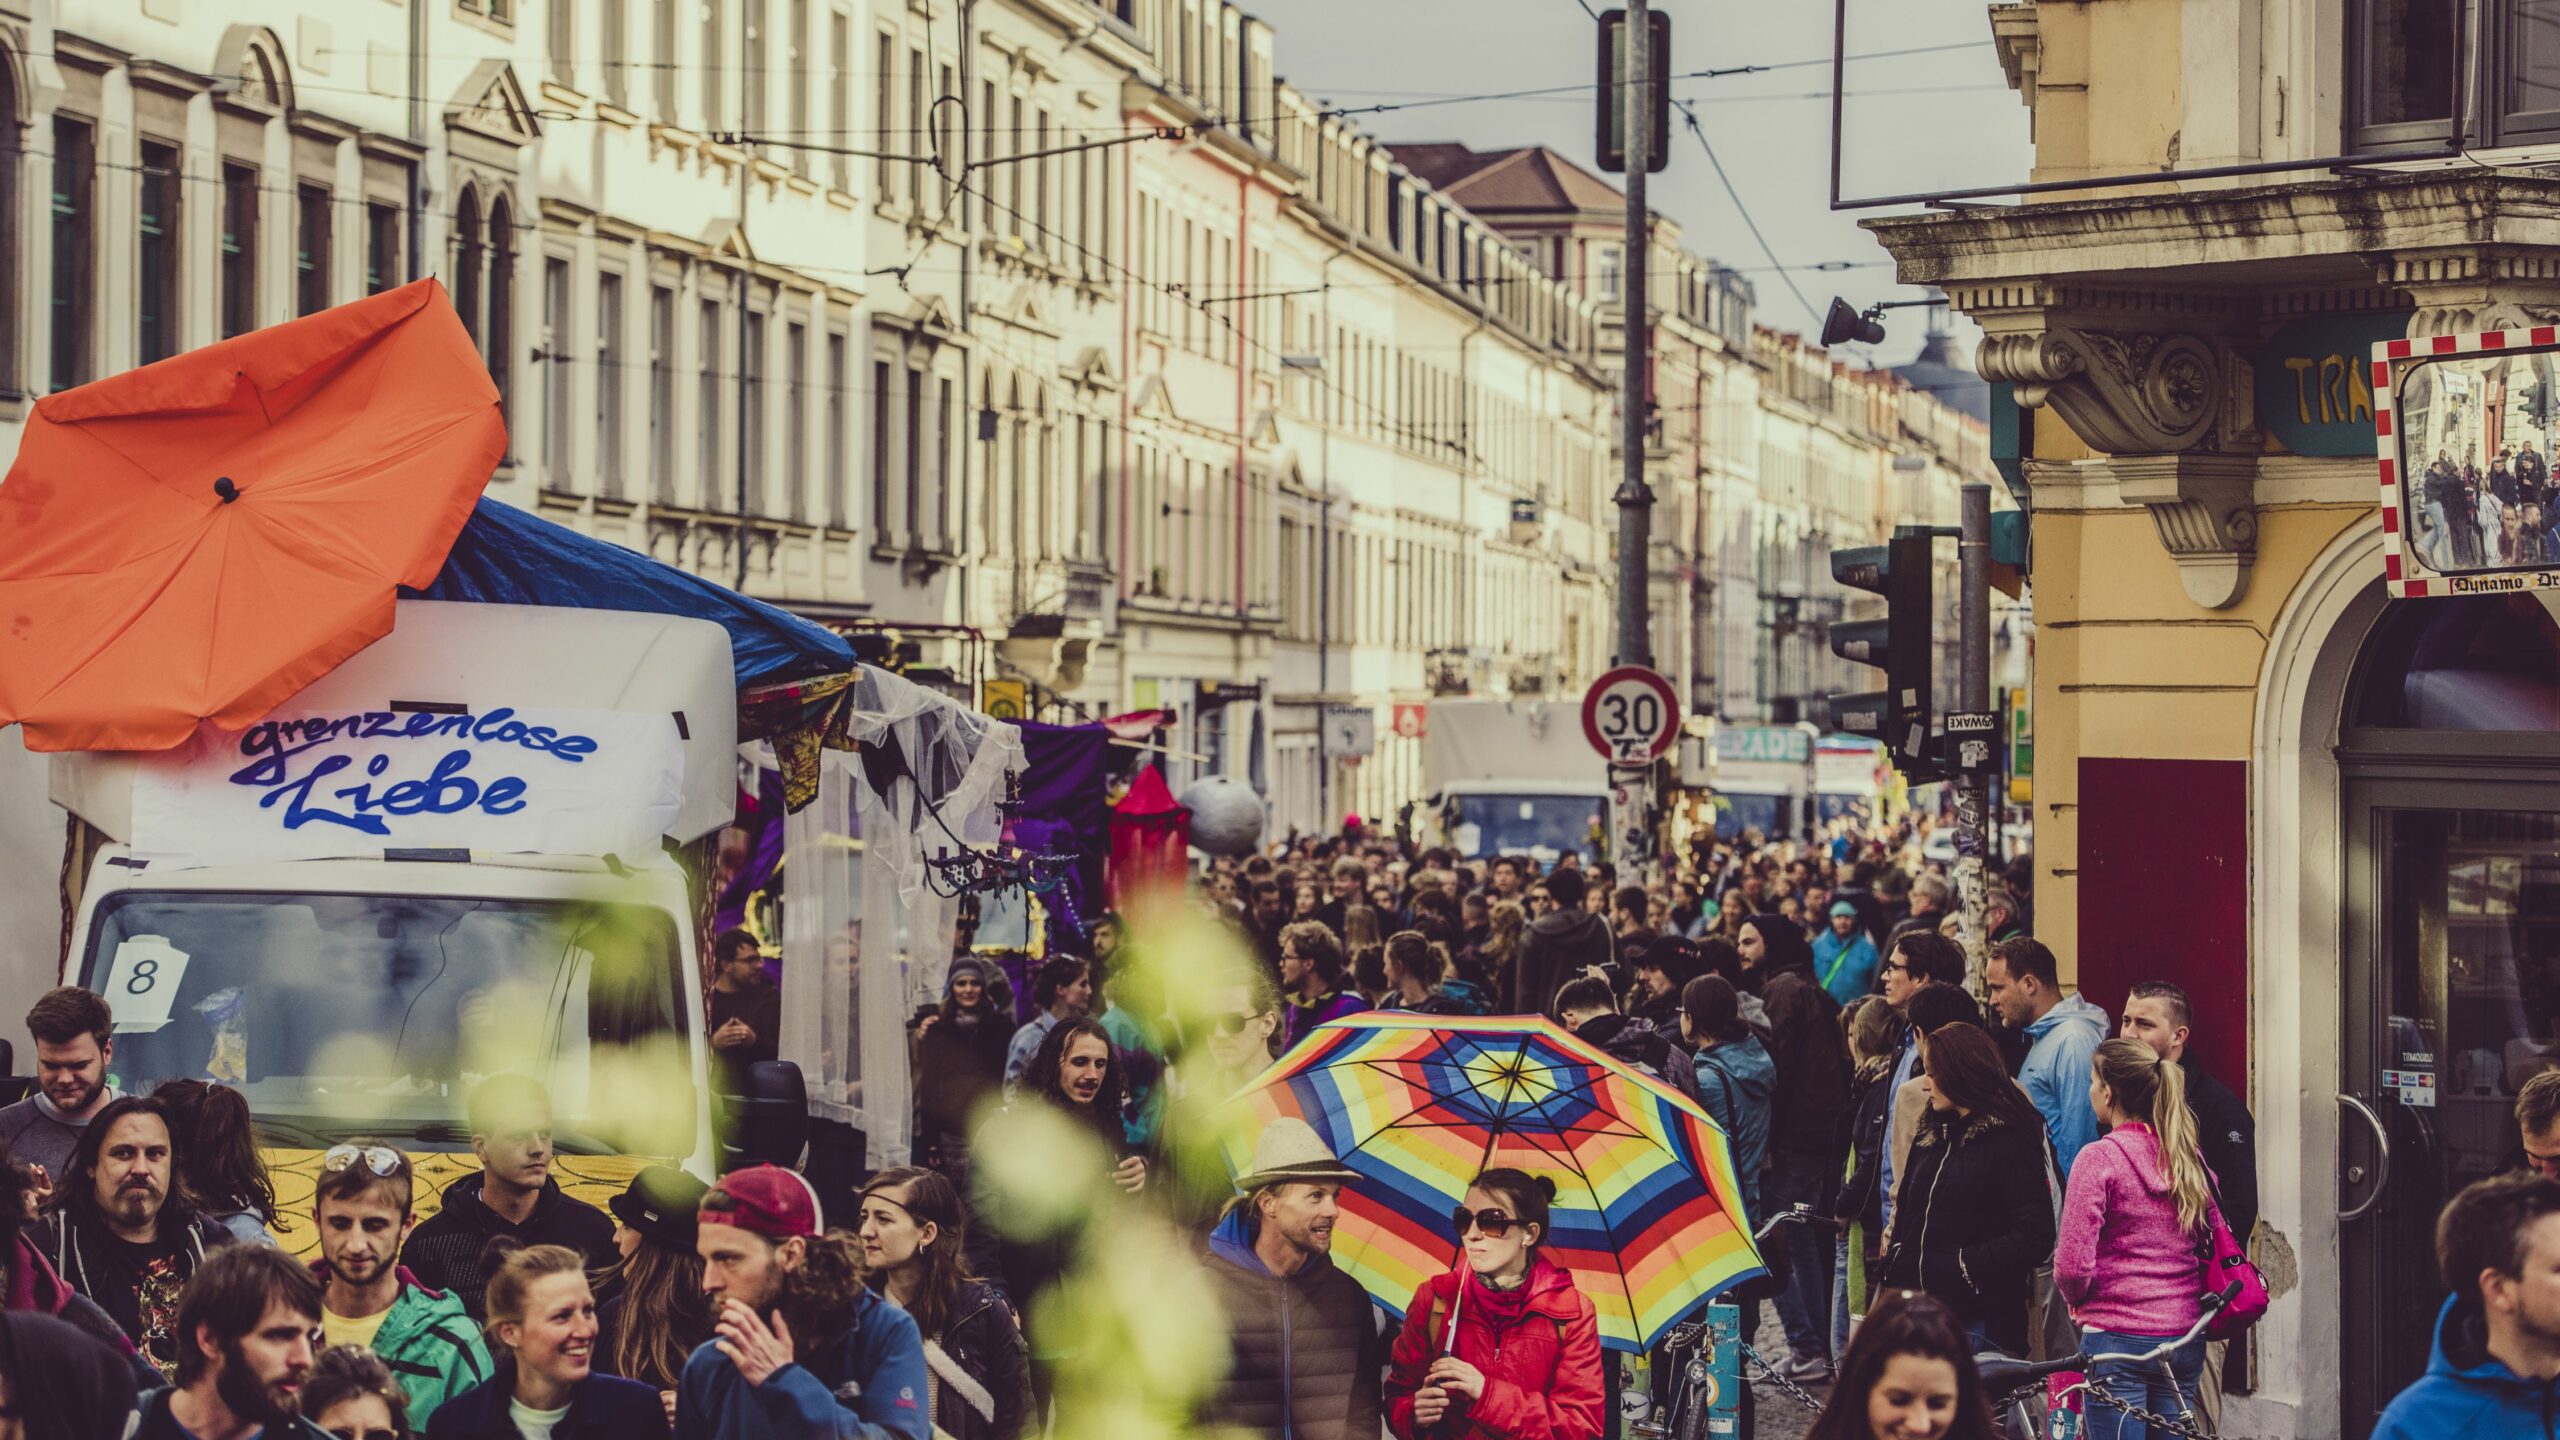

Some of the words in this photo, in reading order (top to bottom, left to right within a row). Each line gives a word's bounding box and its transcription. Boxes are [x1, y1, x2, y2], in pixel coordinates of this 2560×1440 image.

[2284, 354, 2375, 424] TRA
[2455, 577, 2523, 593] Dynamo
[1603, 694, 1658, 736] 30
[229, 708, 598, 786] grenzenlose
[259, 750, 527, 835] Liebe
[127, 960, 158, 994] 8
